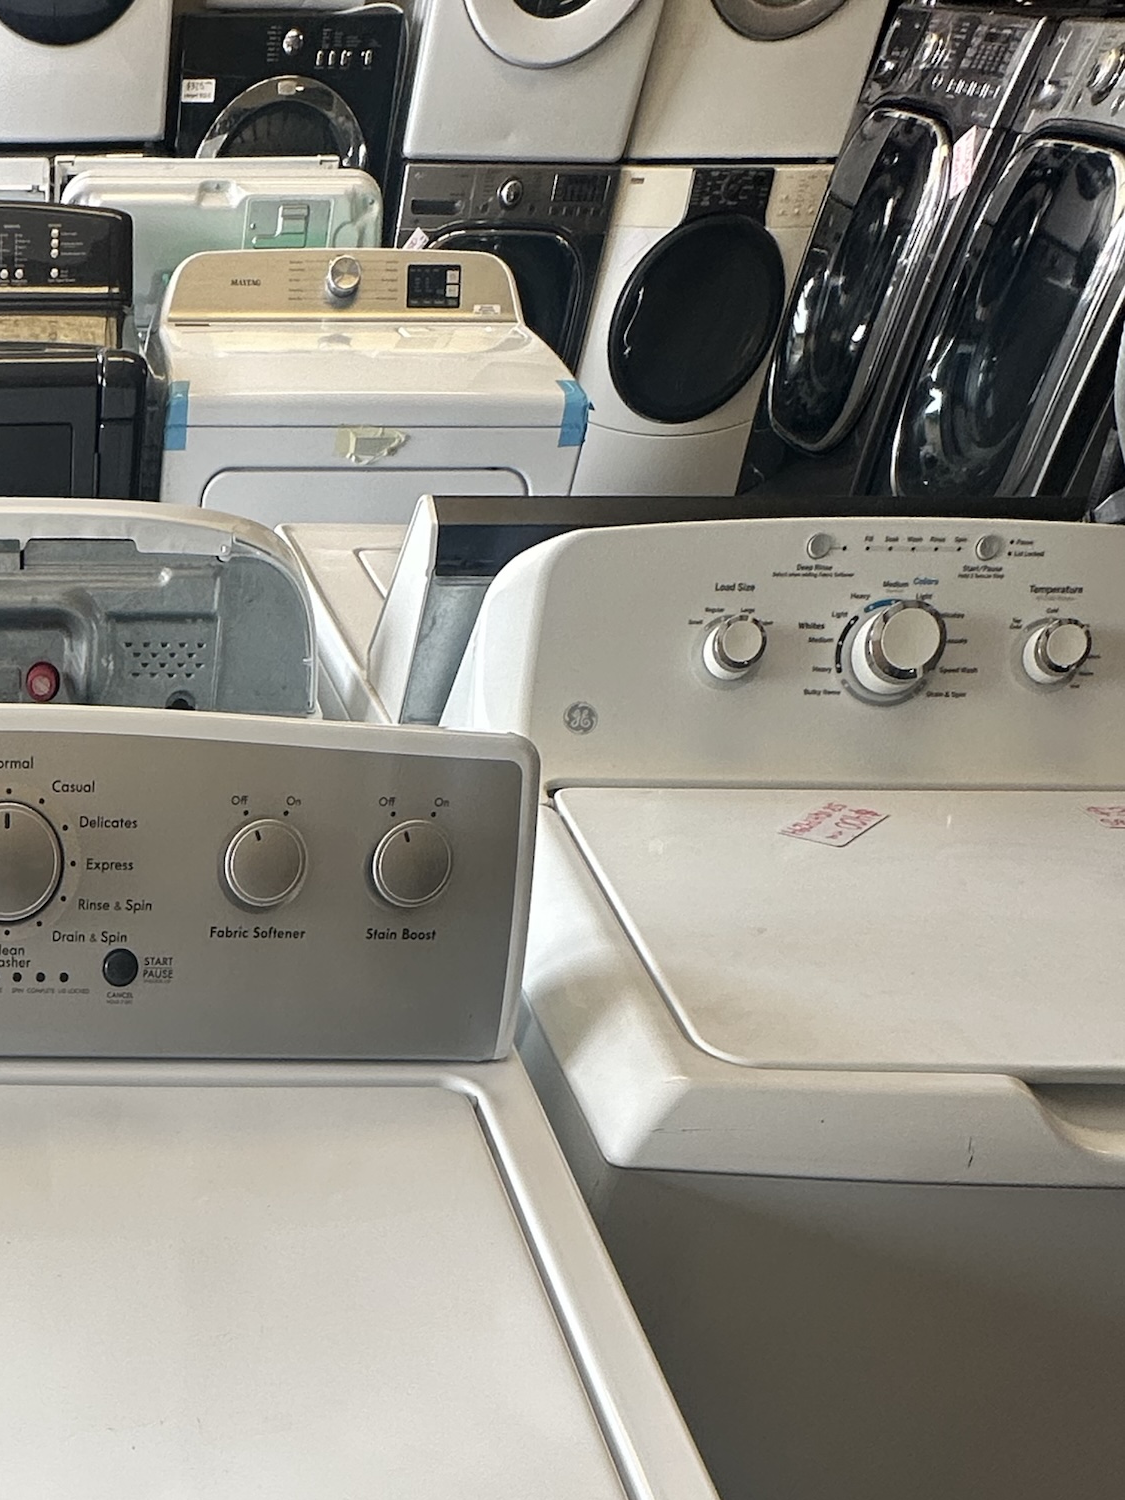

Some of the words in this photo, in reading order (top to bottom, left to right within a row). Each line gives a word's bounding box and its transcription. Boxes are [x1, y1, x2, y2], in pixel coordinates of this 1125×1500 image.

[230, 279, 261, 287] MAYTAG
[796, 563, 814, 571] Deep
[814, 563, 833, 571] Rinse
[962, 564, 1004, 572] Start/Pause
[715, 583, 736, 592] Load
[738, 582, 756, 592] Size
[883, 580, 909, 588] Medium
[914, 577, 939, 586] Colors
[1029, 584, 1084, 595] Temperature
[850, 592, 871, 600] Heavy
[916, 592, 933, 600] Light
[832, 611, 848, 619] Light
[798, 622, 825, 630] Whites
[51, 780, 95, 793] Casual
[231, 795, 249, 806] Off
[286, 795, 302, 806] On
[378, 796, 396, 807] Off
[434, 797, 450, 807] On
[79, 816, 138, 829] Delicates
[86, 858, 134, 873] Express
[78, 899, 110, 911] Rinse
[114, 901, 122, 911] &
[125, 899, 153, 913] Spin
[52, 930, 86, 943] Drain
[89, 932, 97, 942] &
[100, 930, 128, 945] Spin
[209, 926, 250, 940] Fabric
[253, 926, 306, 940] Softener
[365, 928, 398, 941] Stain
[402, 928, 436, 941] Boost
[144, 957, 173, 966] START
[143, 969, 173, 979] PAUSE
[106, 991, 134, 999] CANCEL
